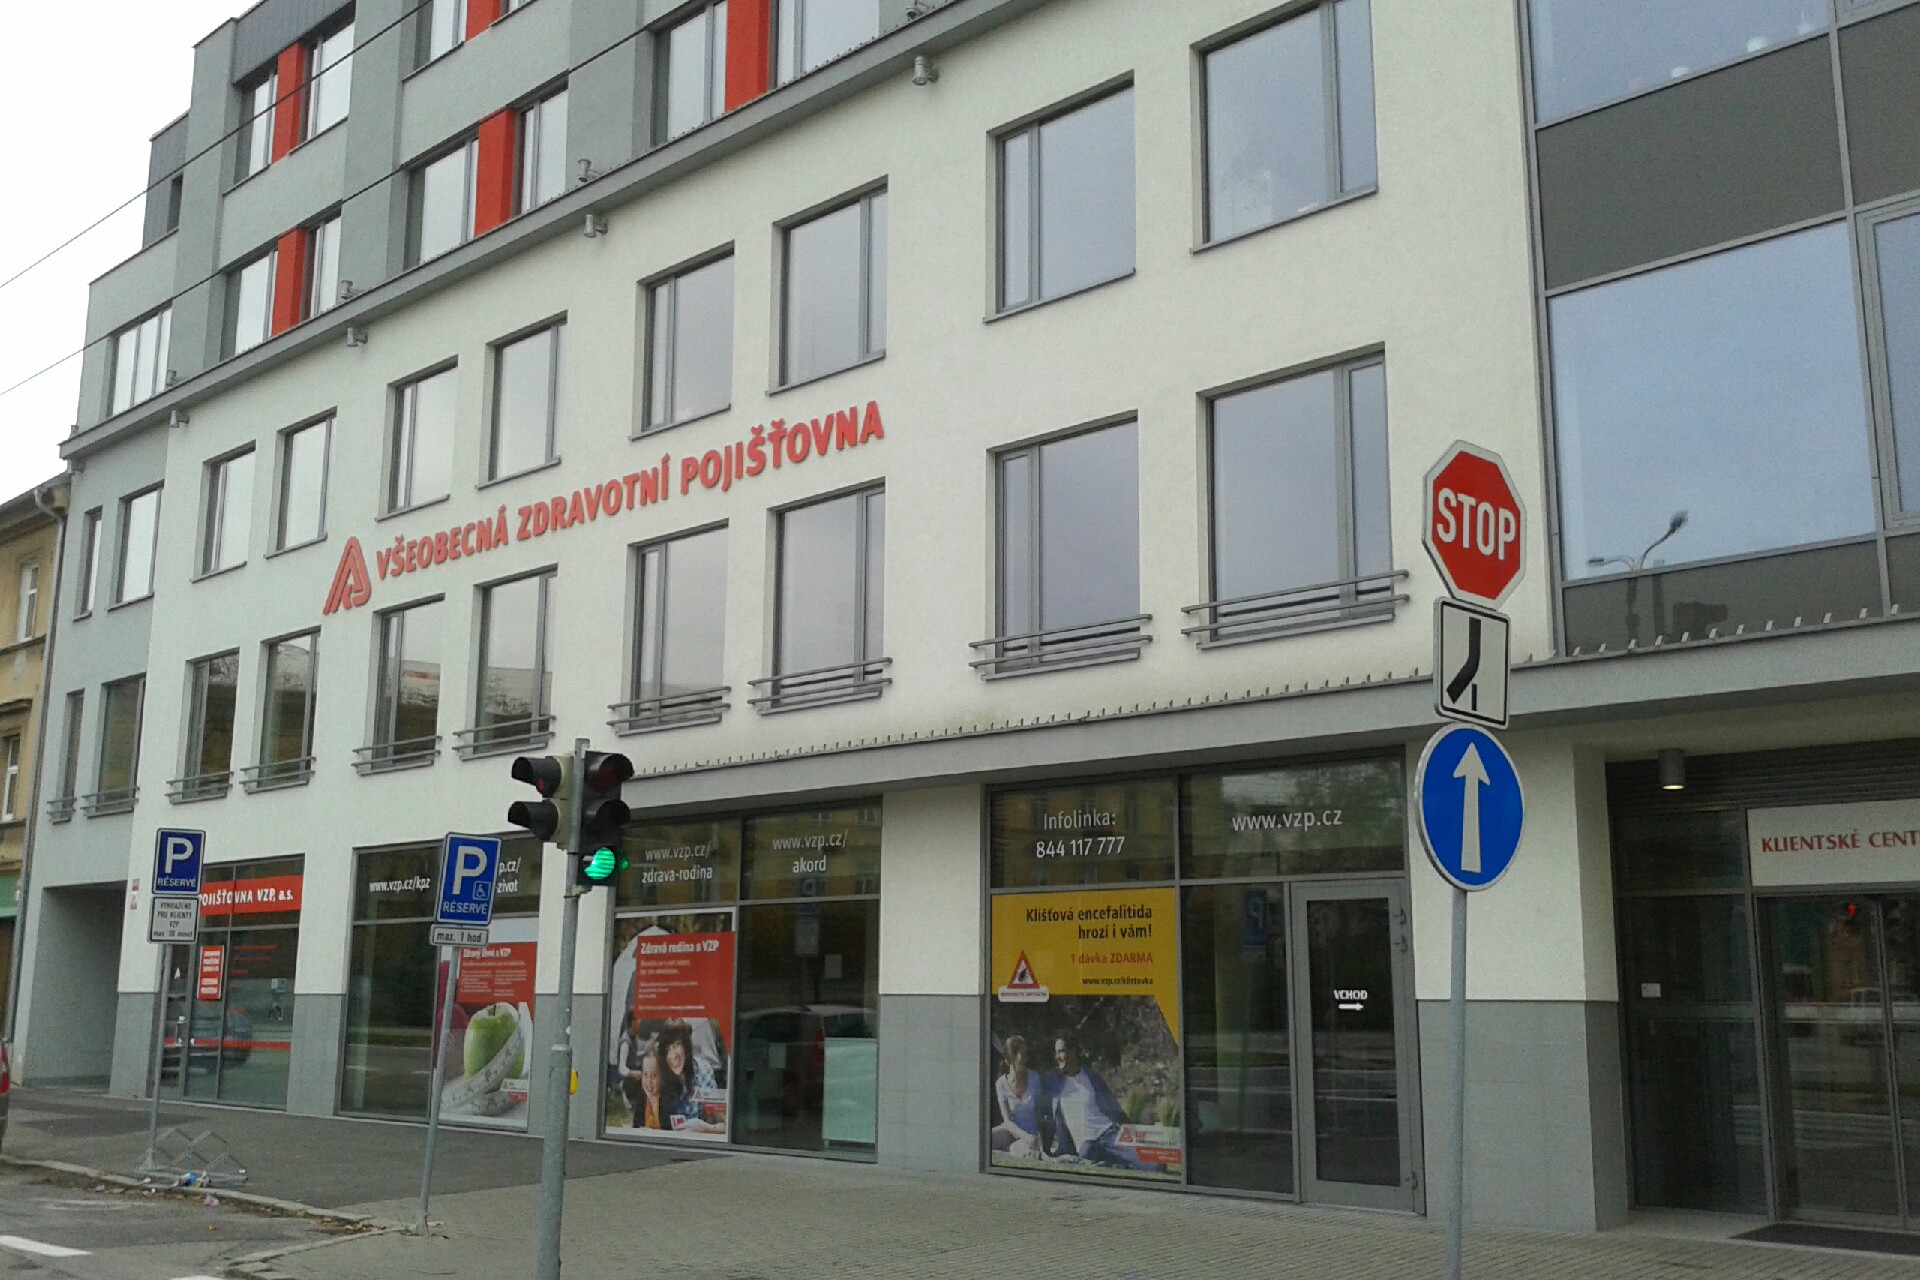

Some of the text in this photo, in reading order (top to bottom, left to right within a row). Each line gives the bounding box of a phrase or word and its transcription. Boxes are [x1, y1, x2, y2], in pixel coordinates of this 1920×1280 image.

[376, 400, 885, 581] VŠEOBECNÁ ZDRAVOTNÍ POJIŠŤOVNA
[1437, 487, 1516, 560] STOP
[1043, 810, 1117, 830] Infolinka:
[1231, 809, 1343, 832] www.vzp.cz
[772, 828, 849, 851] www.vzp.cz/
[1036, 835, 1126, 859] 844 117 777
[1761, 828, 1861, 853] KLIENTSKÉ
[165, 836, 194, 874] P
[645, 839, 712, 862] www.vzp.cz/
[452, 845, 488, 895] P
[641, 864, 713, 884] zdrava-rodina
[792, 854, 827, 874] akord
[369, 875, 431, 894] www.vzp.cz/kpz
[1078, 903, 1153, 921] encefalitida
[467, 931, 482, 943] hod
[1113, 923, 1117, 939] i
[1120, 922, 1153, 939] vám!
[1110, 951, 1153, 964] ZDARMA
[1333, 989, 1368, 1000] VCHOD
